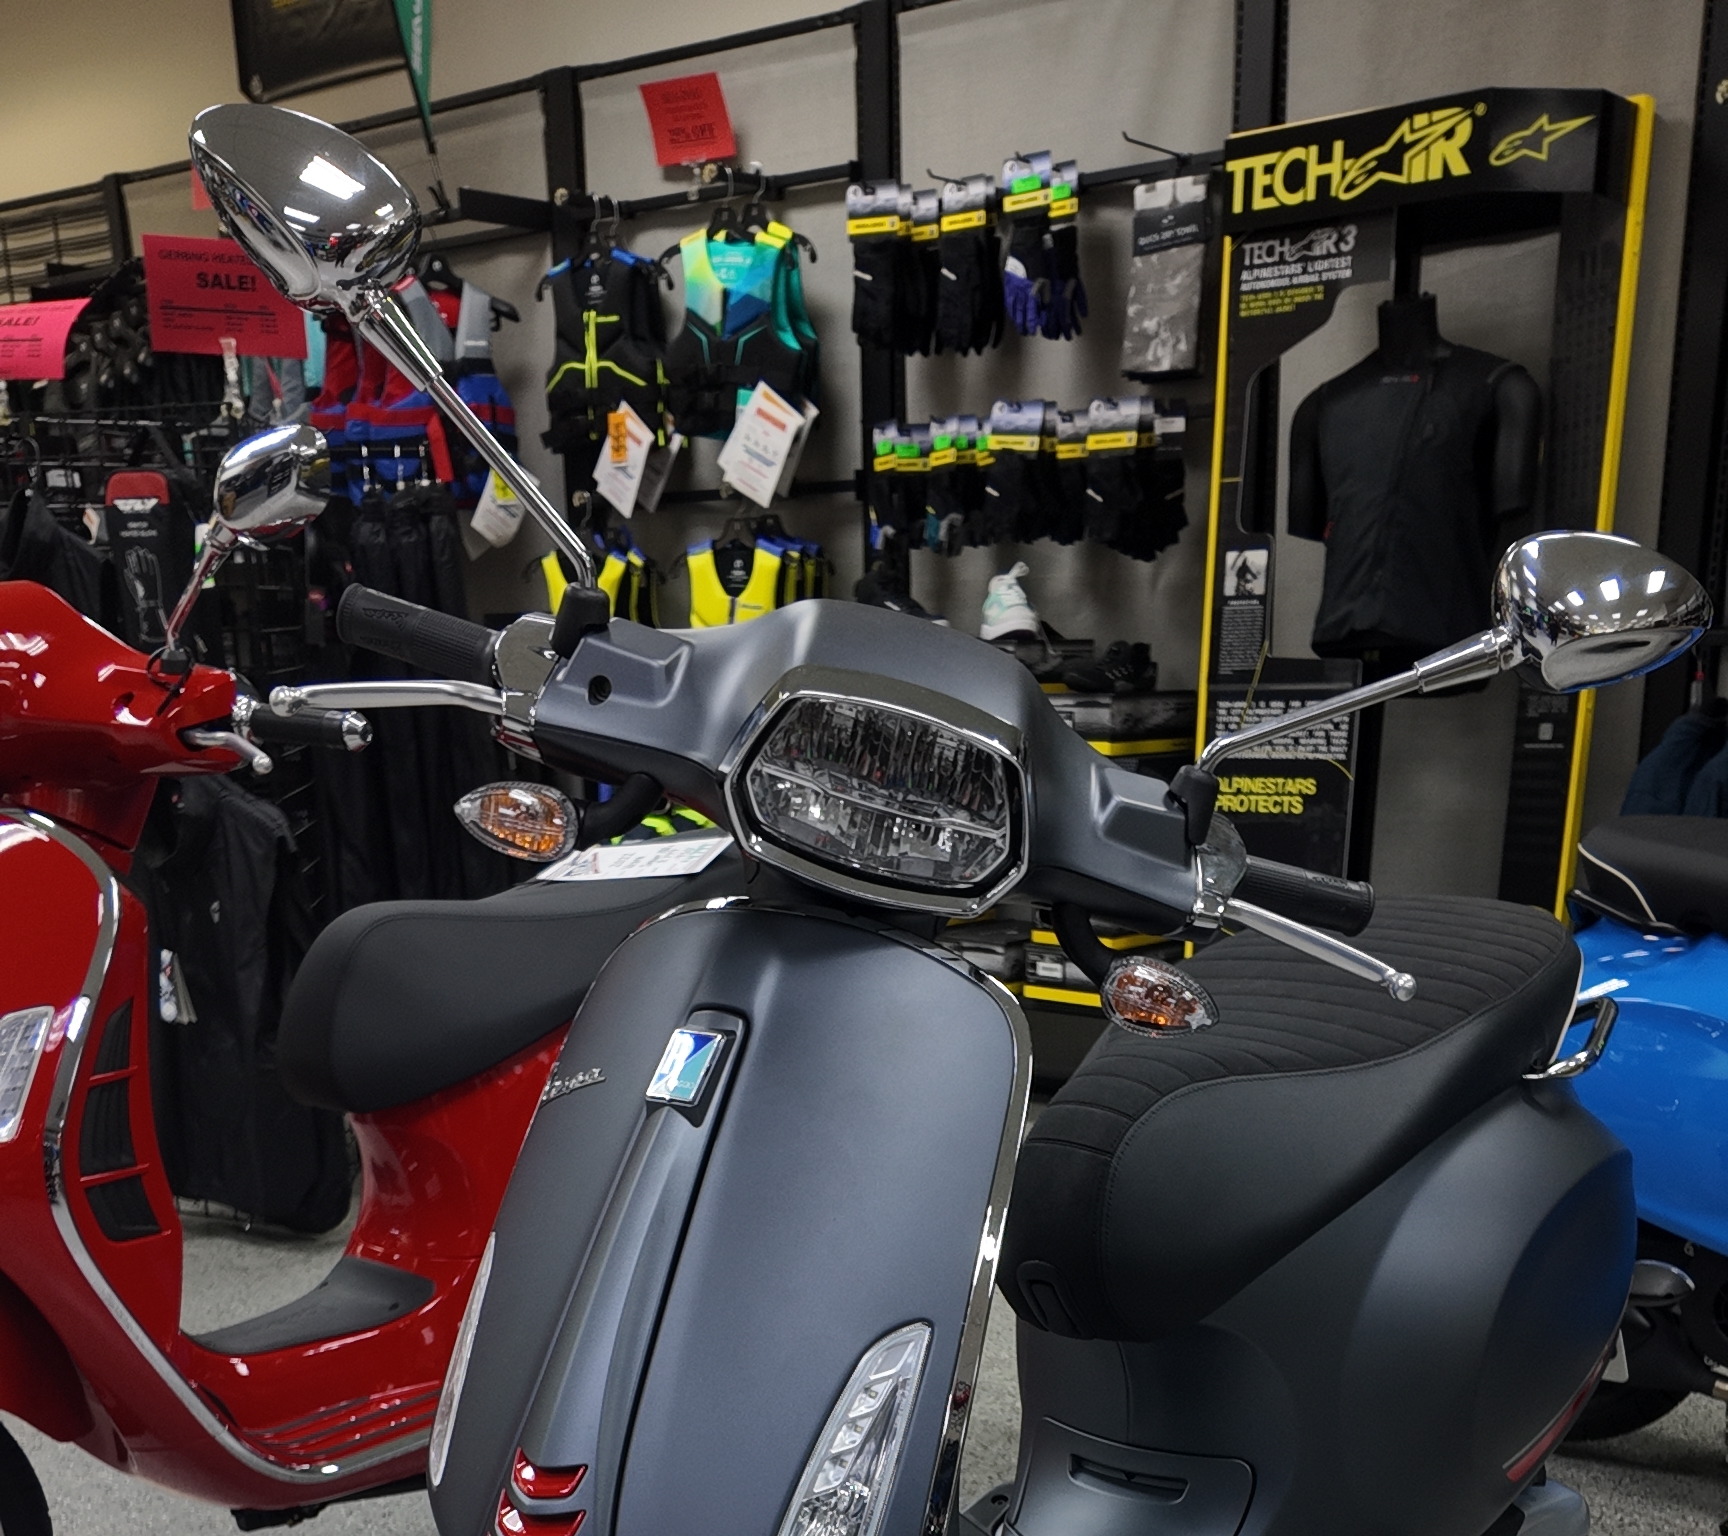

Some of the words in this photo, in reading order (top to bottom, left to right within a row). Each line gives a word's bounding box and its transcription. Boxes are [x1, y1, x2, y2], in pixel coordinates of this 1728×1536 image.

[1340, 224, 1358, 252] 3
[196, 272, 257, 292] SALE!
[1214, 794, 1304, 814] PROTECTS
